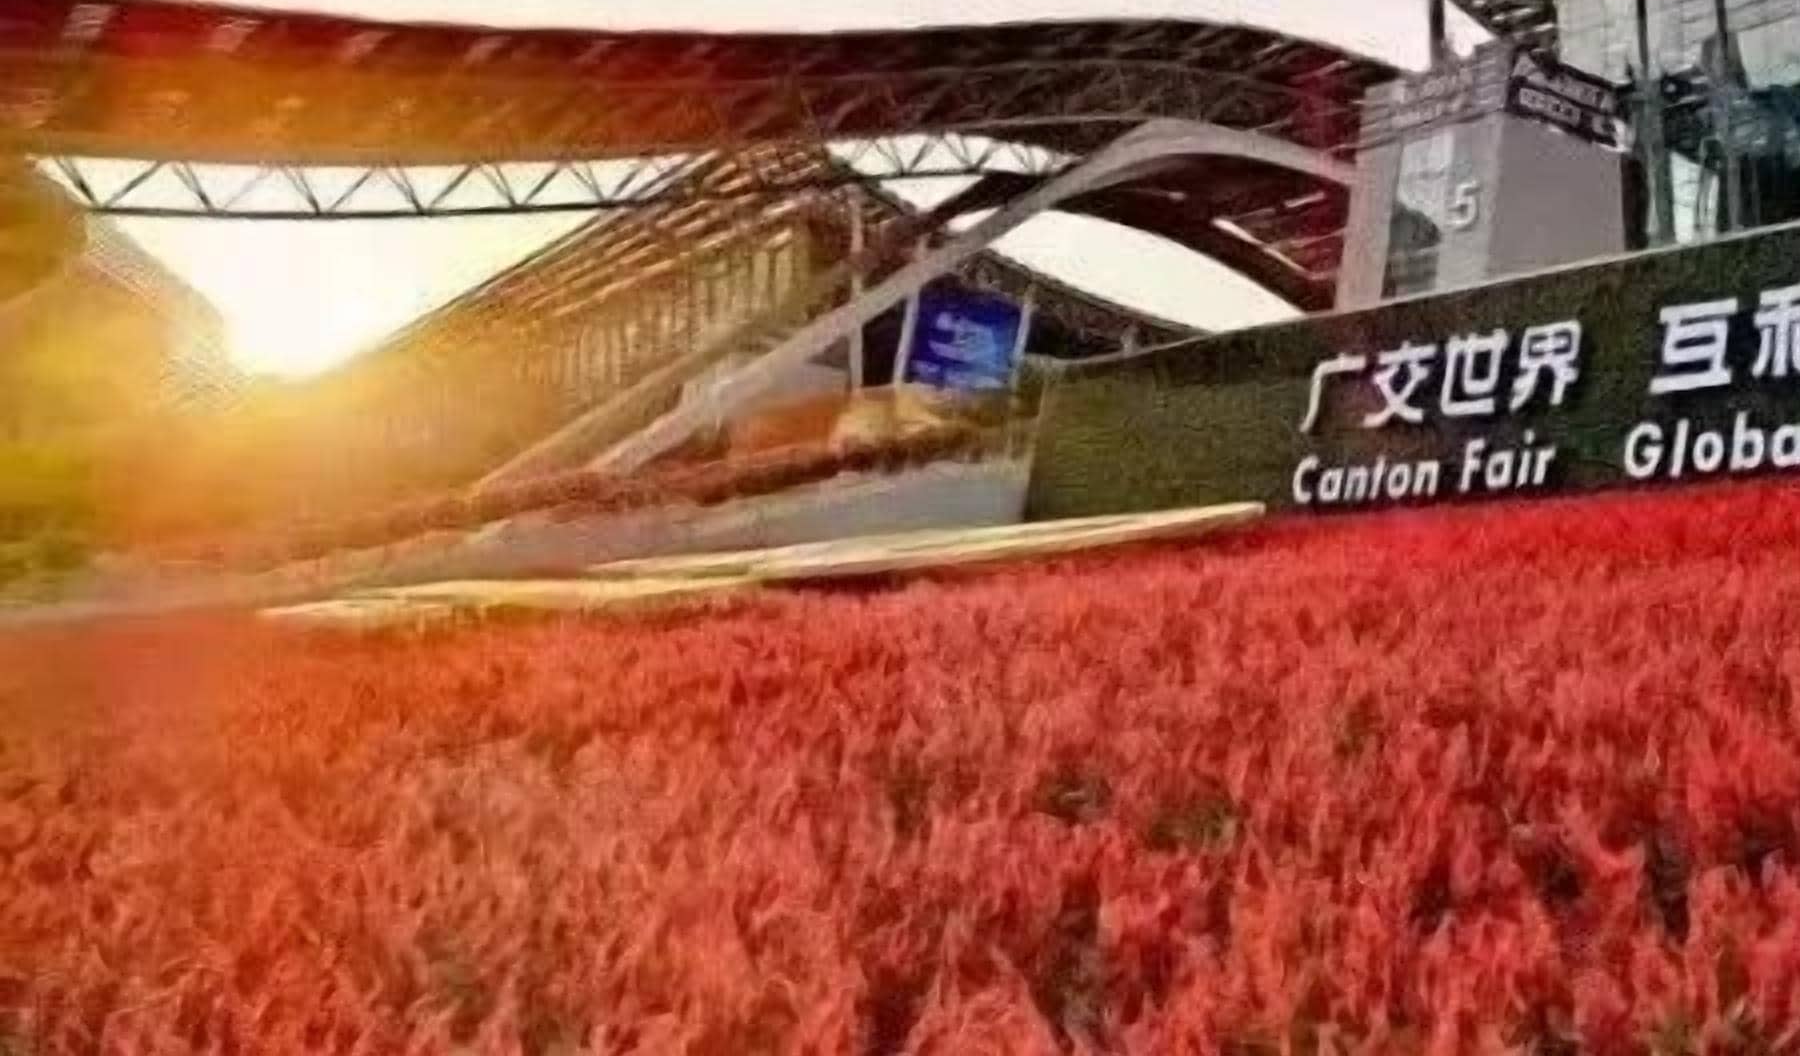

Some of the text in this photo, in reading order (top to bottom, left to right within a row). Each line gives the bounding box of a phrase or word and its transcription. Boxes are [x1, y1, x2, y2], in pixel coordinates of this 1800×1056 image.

[1448, 179, 1479, 229] 5
[1300, 319, 1582, 433] 广交世界
[1292, 454, 1440, 504] Canton
[1459, 428, 1556, 493] Fair
